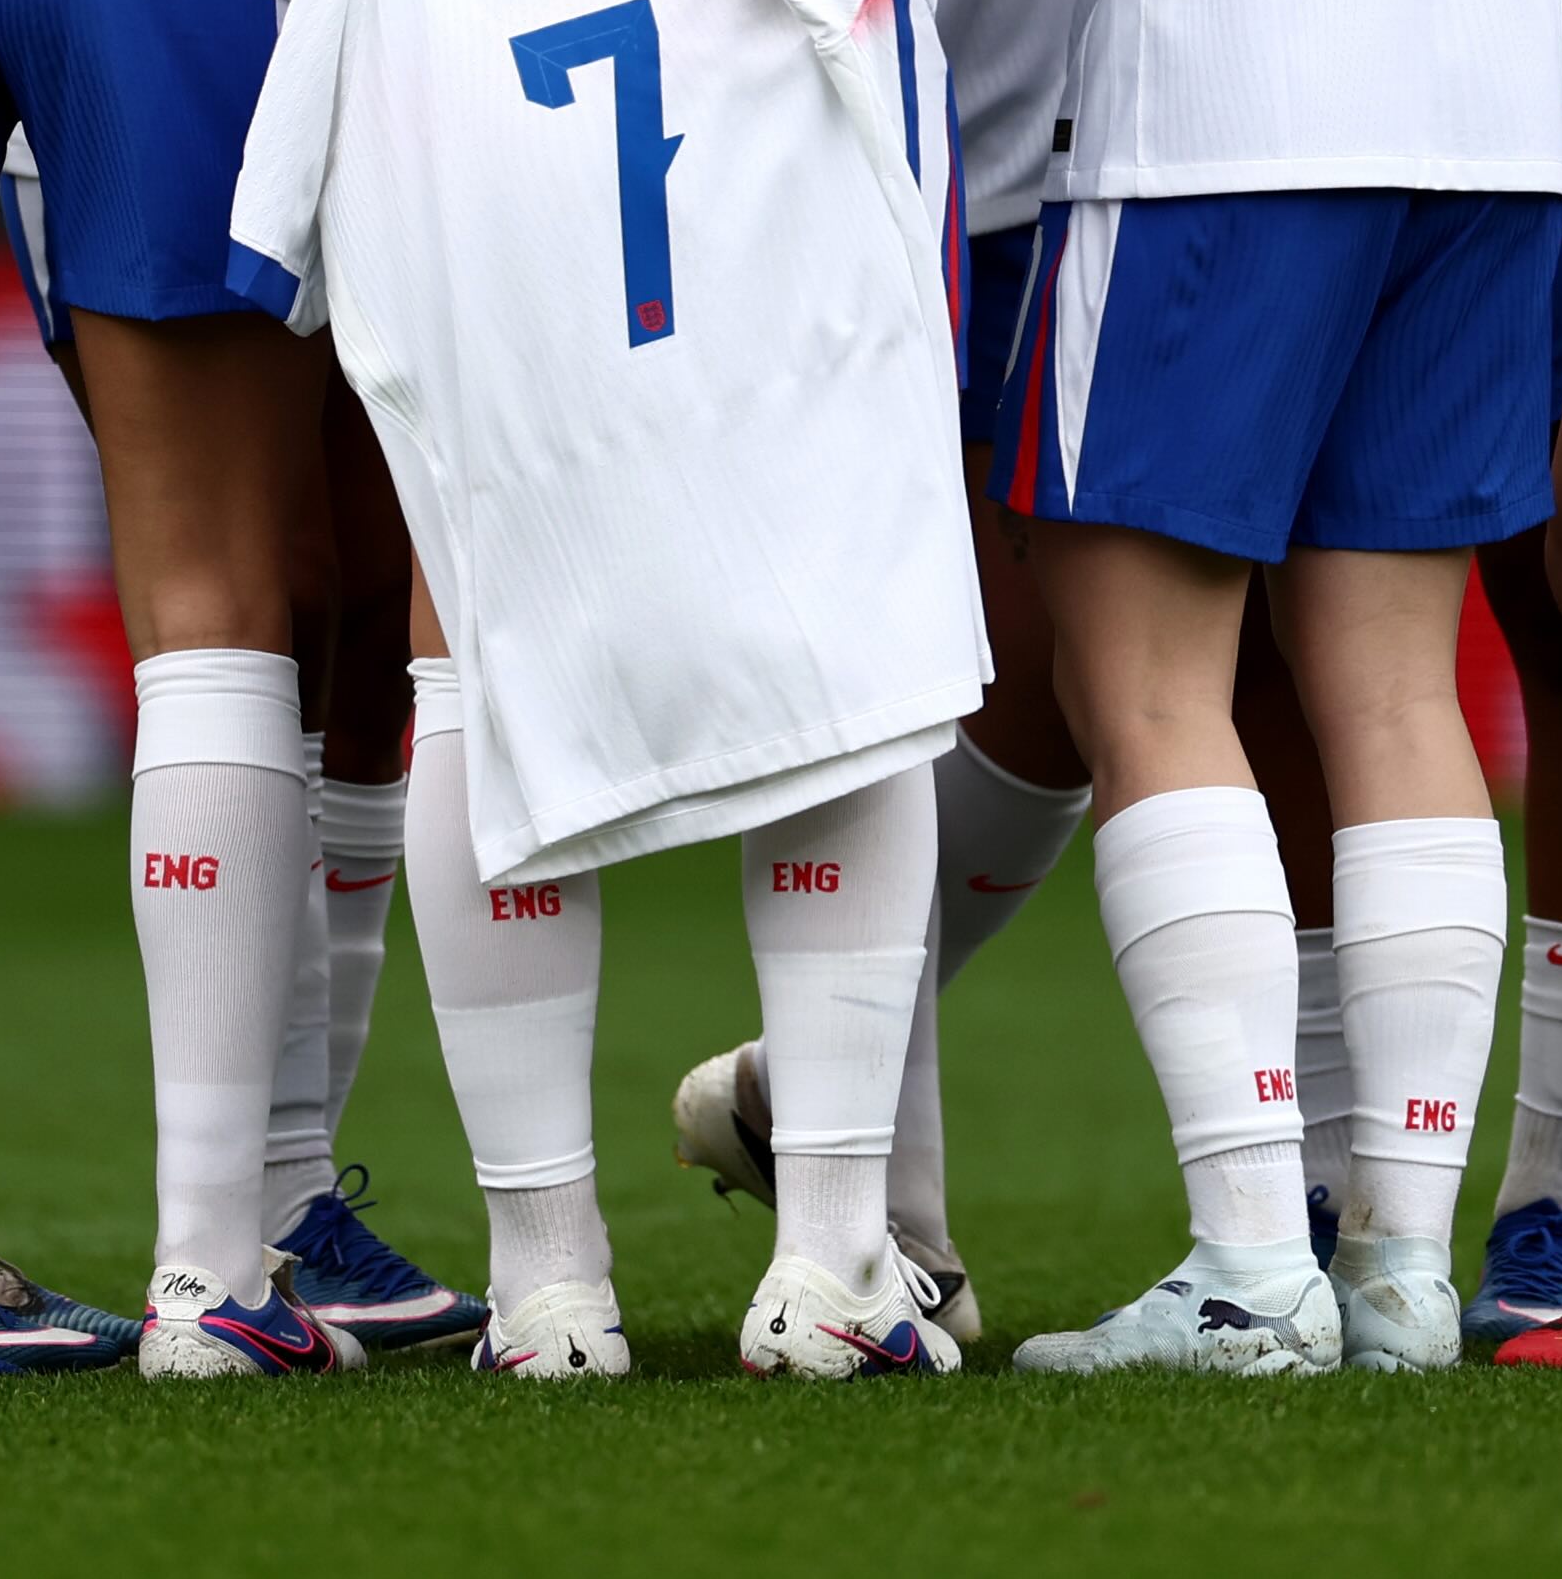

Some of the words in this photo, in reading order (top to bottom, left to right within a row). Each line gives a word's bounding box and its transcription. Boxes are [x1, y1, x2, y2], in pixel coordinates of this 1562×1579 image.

[144, 853, 220, 891] ENG
[771, 862, 841, 894] ENG
[489, 884, 562, 922] ENG
[1254, 1069, 1295, 1104] ENG
[1405, 1099, 1457, 1133] ENG
[162, 1272, 207, 1298] Nike
